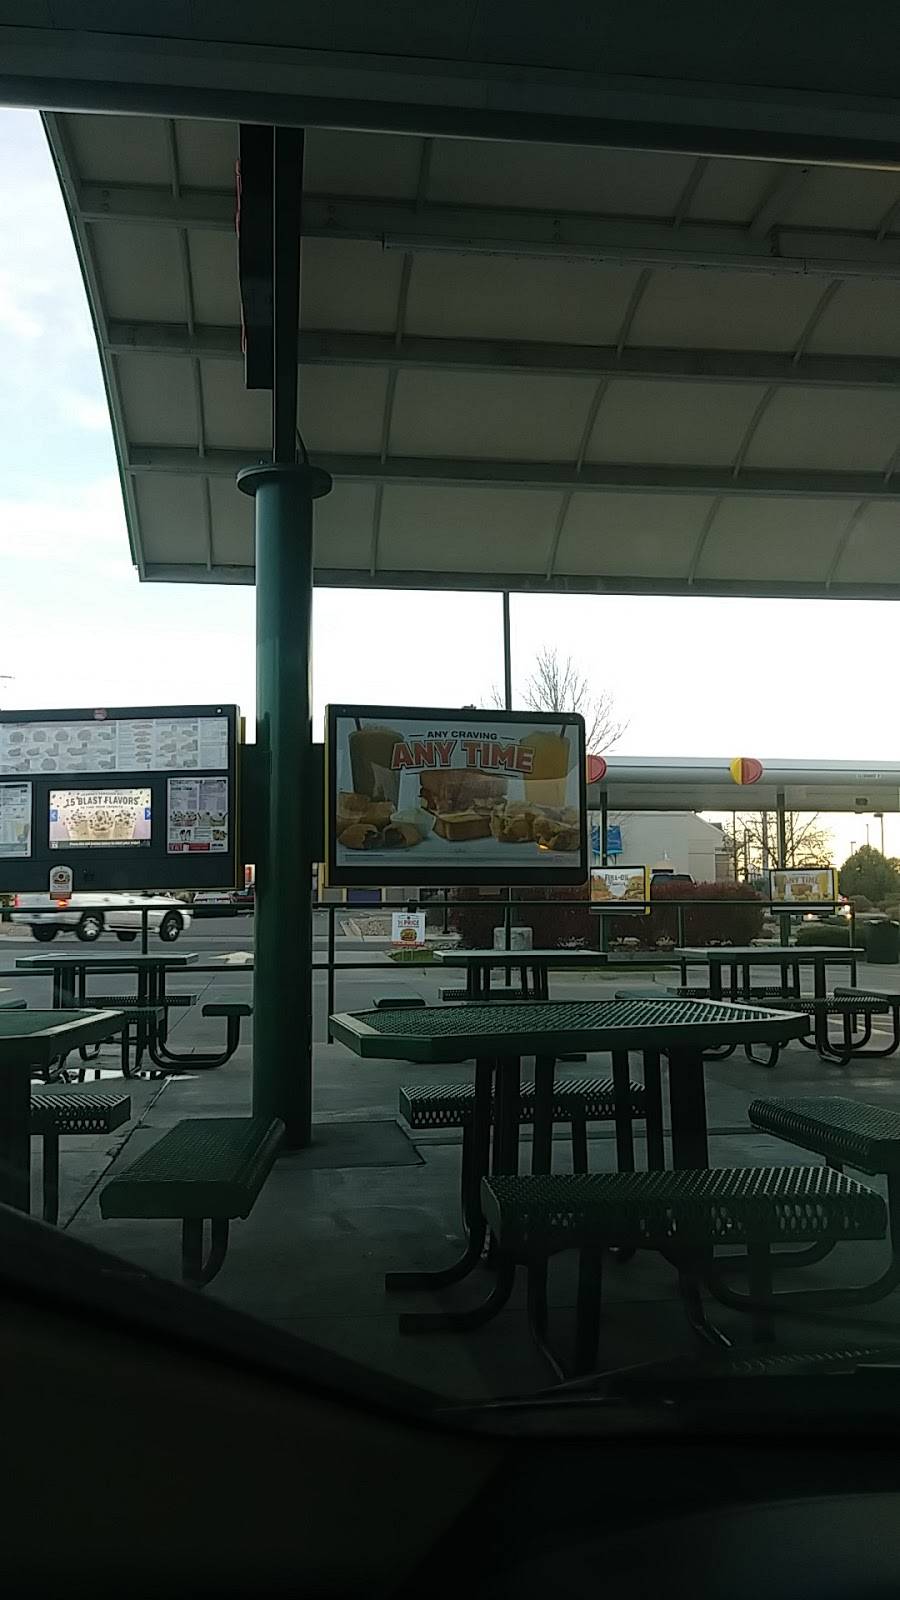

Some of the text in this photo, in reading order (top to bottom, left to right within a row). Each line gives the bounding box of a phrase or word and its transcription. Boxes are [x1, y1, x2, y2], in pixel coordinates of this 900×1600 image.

[451, 731, 498, 740] CRAVING
[391, 740, 536, 774] ANY TIME
[66, 796, 139, 806] 15 BLAST FLAVORS
